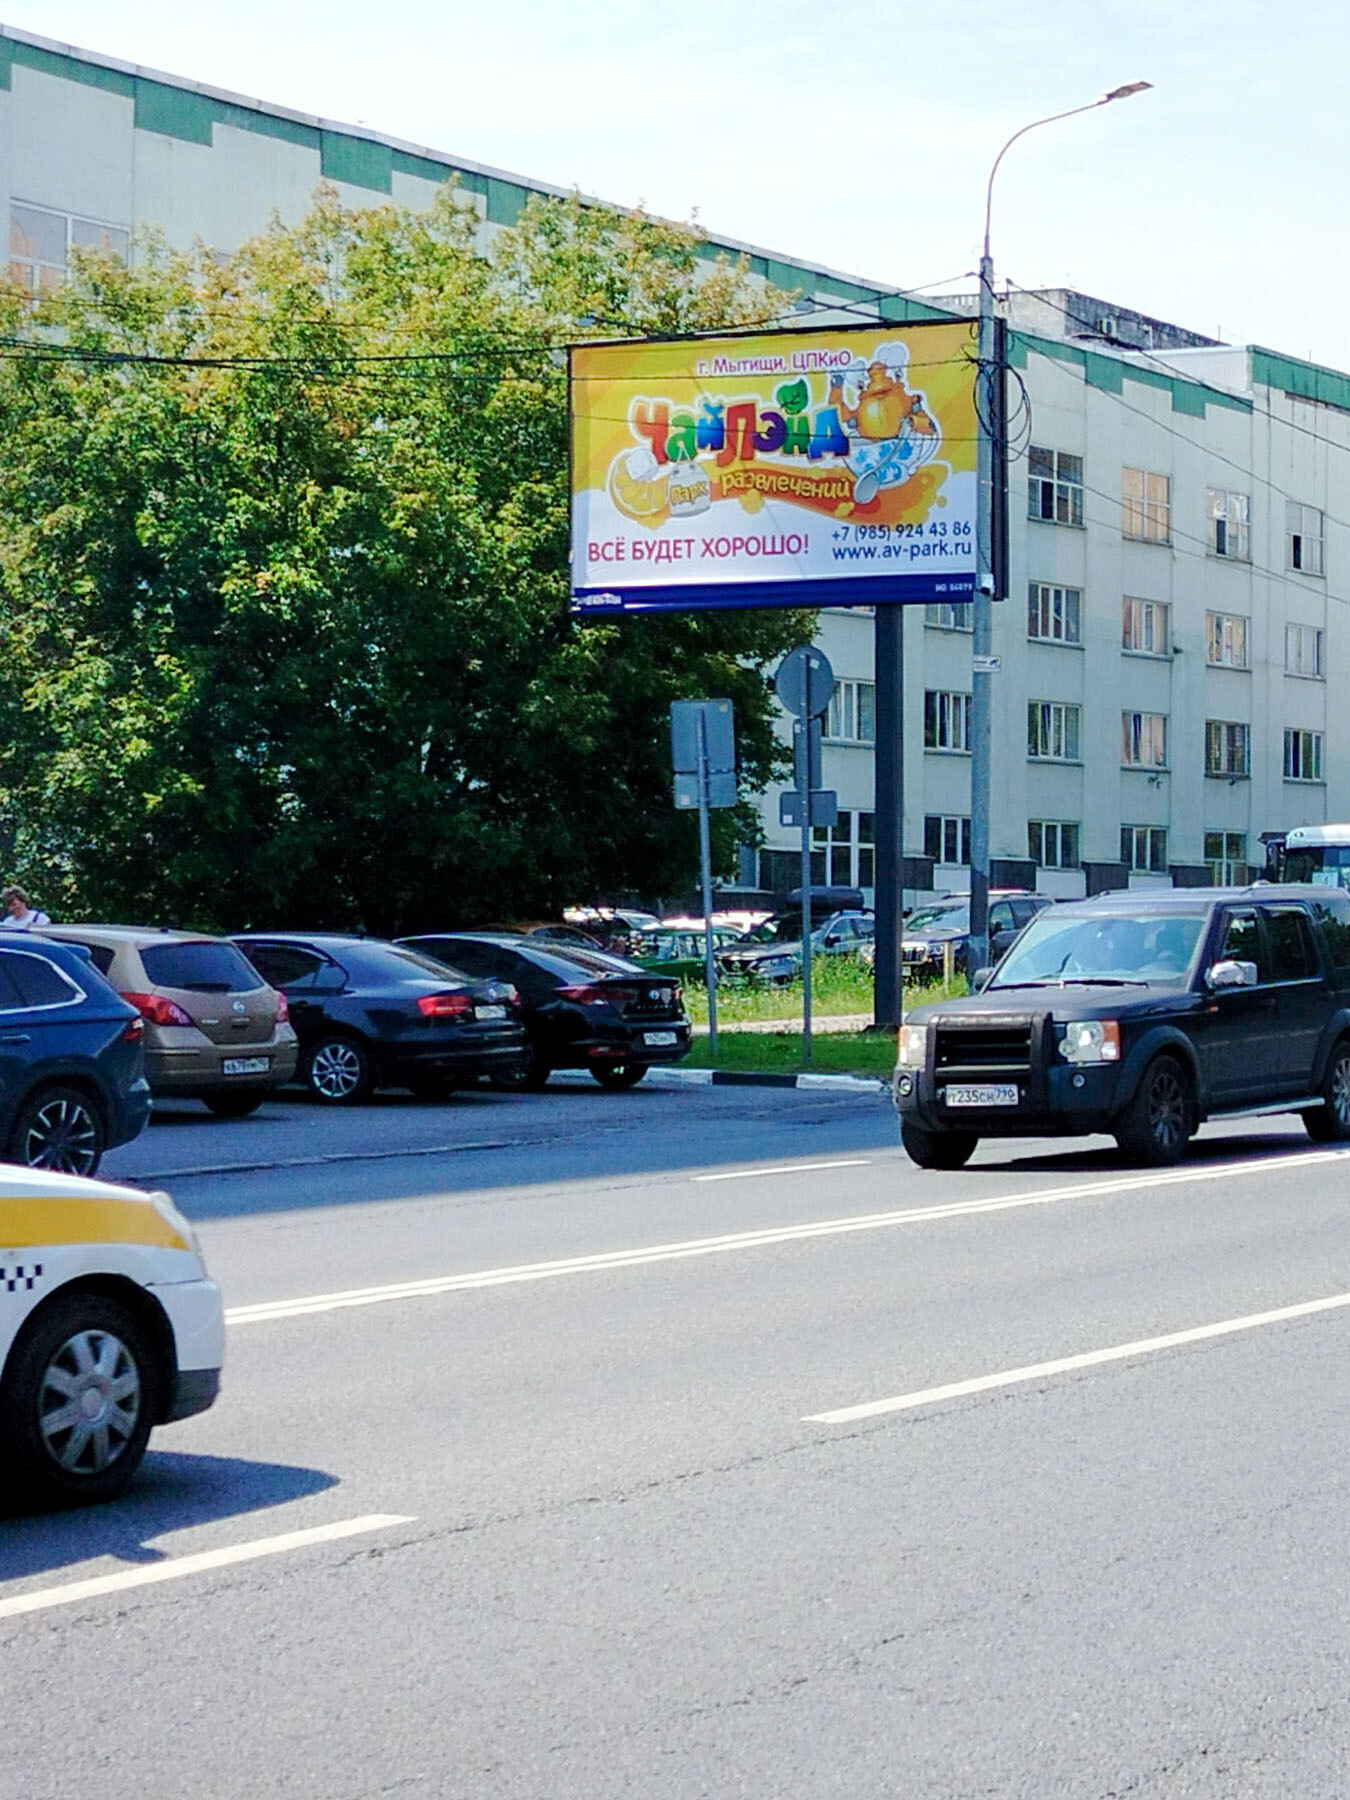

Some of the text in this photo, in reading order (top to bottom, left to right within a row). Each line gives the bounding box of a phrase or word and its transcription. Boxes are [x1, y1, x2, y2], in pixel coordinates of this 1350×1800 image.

[713, 357, 788, 374] Мытищи,
[792, 350, 852, 371] ЦПКиО
[720, 471, 851, 498] развлечений
[831, 521, 972, 543] +7 (985) 924 43 86
[587, 533, 810, 564] ВСЁ БУДЕТ ХОРОШО!
[831, 539, 972, 561] www.av-park.ru
